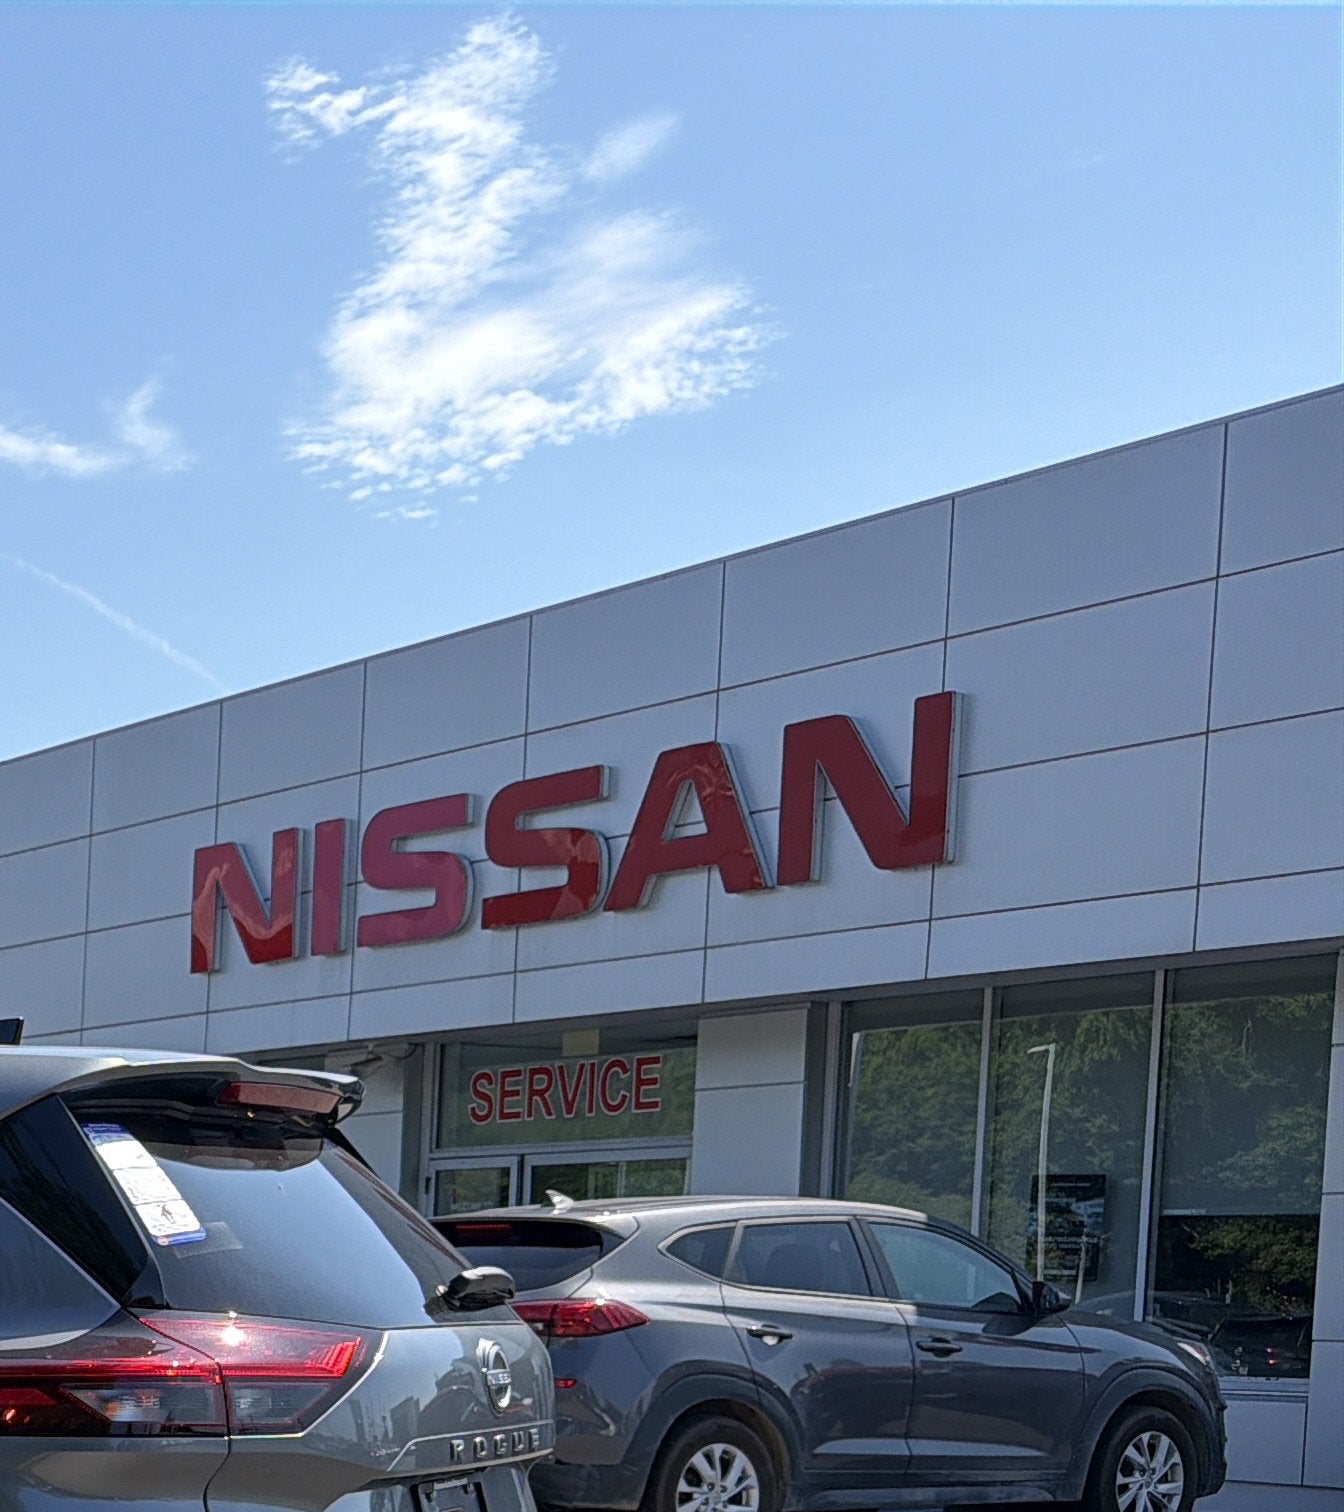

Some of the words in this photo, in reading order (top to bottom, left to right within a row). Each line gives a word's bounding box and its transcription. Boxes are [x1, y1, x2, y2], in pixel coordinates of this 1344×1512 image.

[190, 691, 962, 975] NISSAN
[468, 1055, 662, 1125] SERVICE
[450, 1428, 540, 1462] ROGUE
